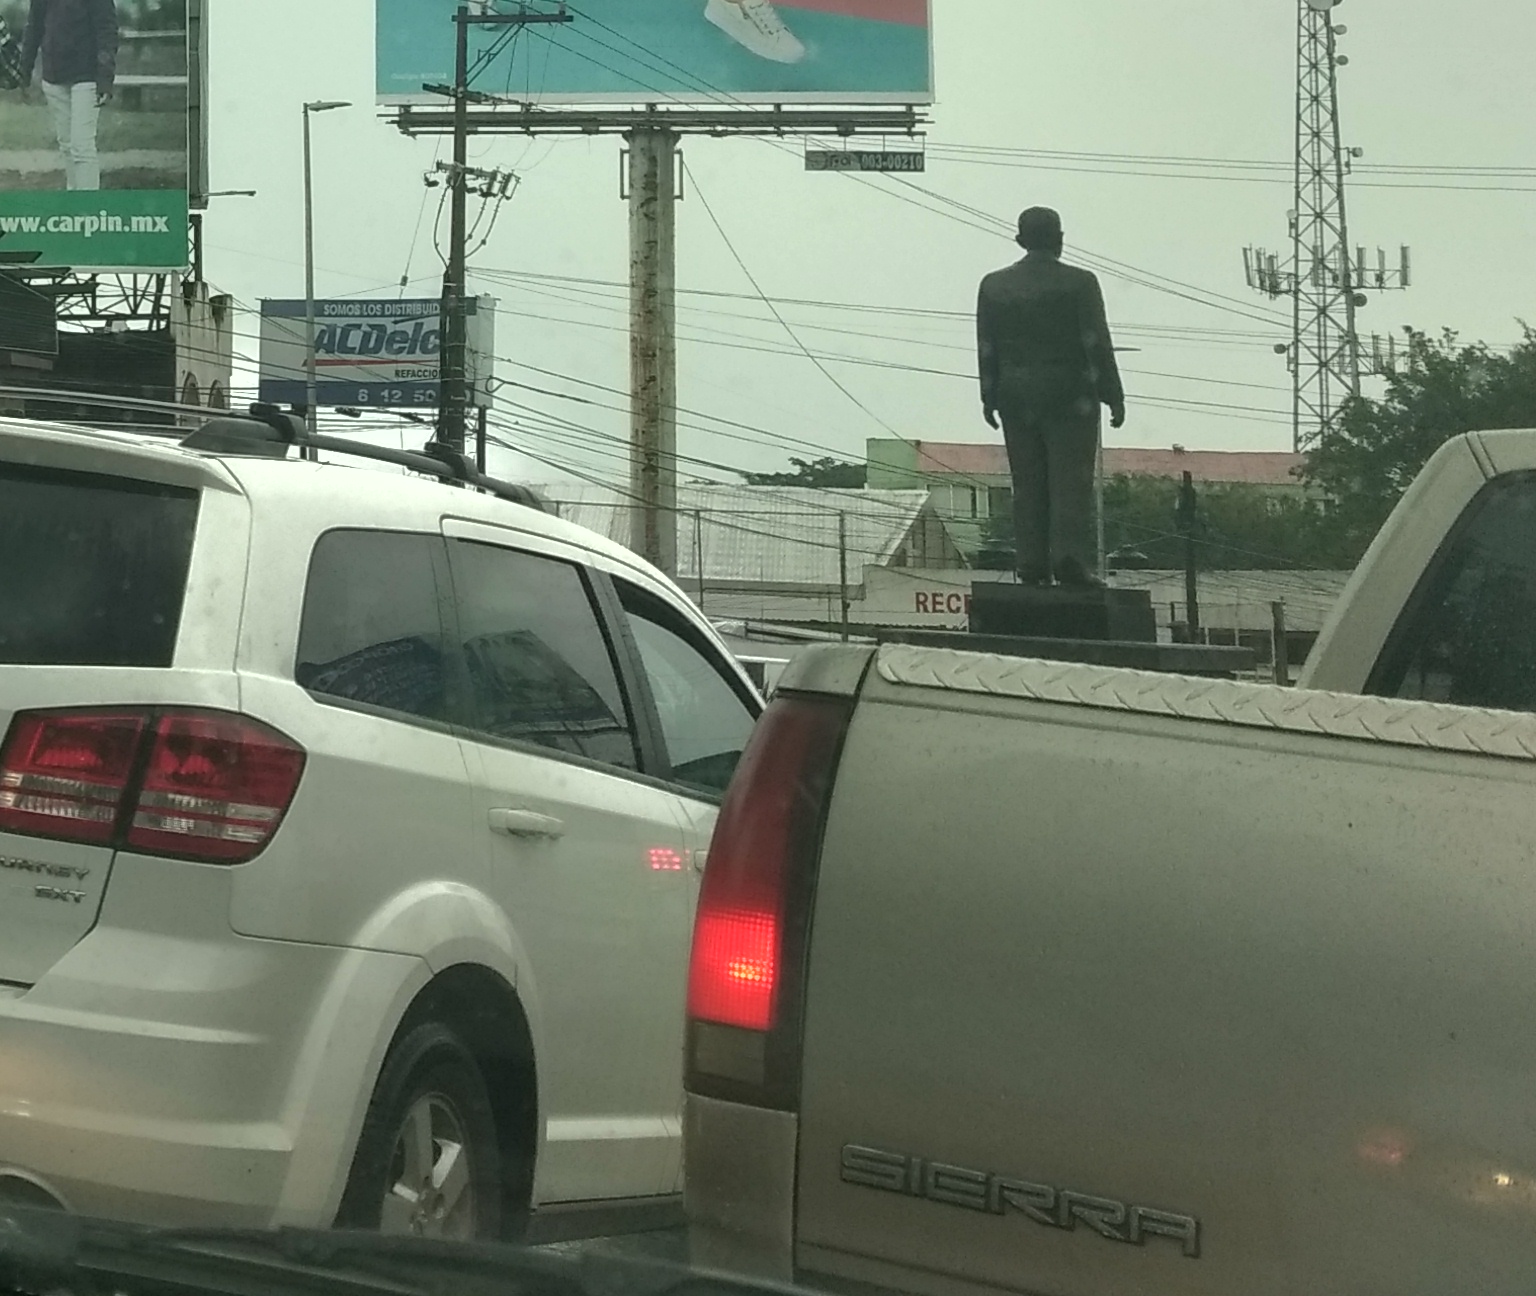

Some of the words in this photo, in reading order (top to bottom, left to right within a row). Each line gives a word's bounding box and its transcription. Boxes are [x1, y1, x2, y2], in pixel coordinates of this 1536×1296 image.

[861, 154, 923, 170] 003-00210
[323, 304, 360, 316] SOMOS
[363, 304, 382, 316] LOS
[841, 1143, 1201, 1259] SIERRA
